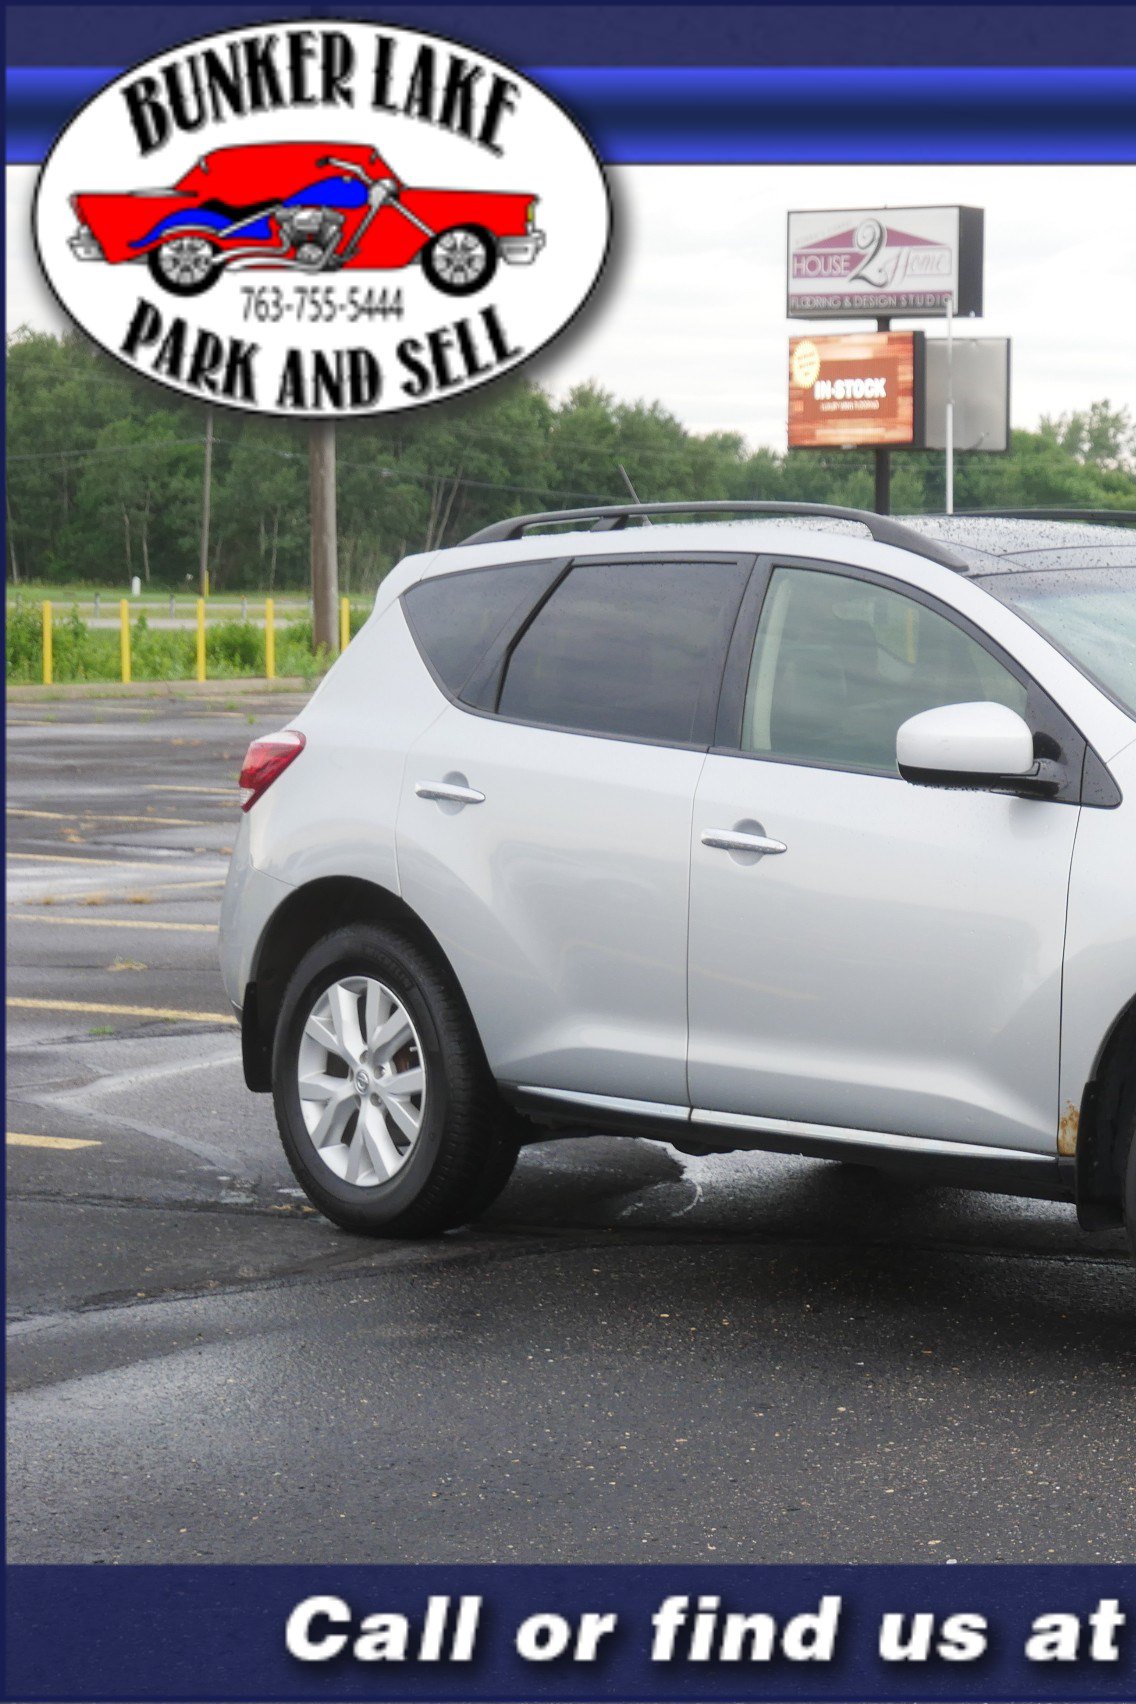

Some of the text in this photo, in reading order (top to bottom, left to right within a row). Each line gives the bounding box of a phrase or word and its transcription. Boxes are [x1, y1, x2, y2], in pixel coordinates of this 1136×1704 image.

[794, 254, 850, 278] HOUSE
[848, 217, 888, 288] 2
[854, 294, 897, 309] DESIGN
[814, 377, 887, 400] IN-STOCK
